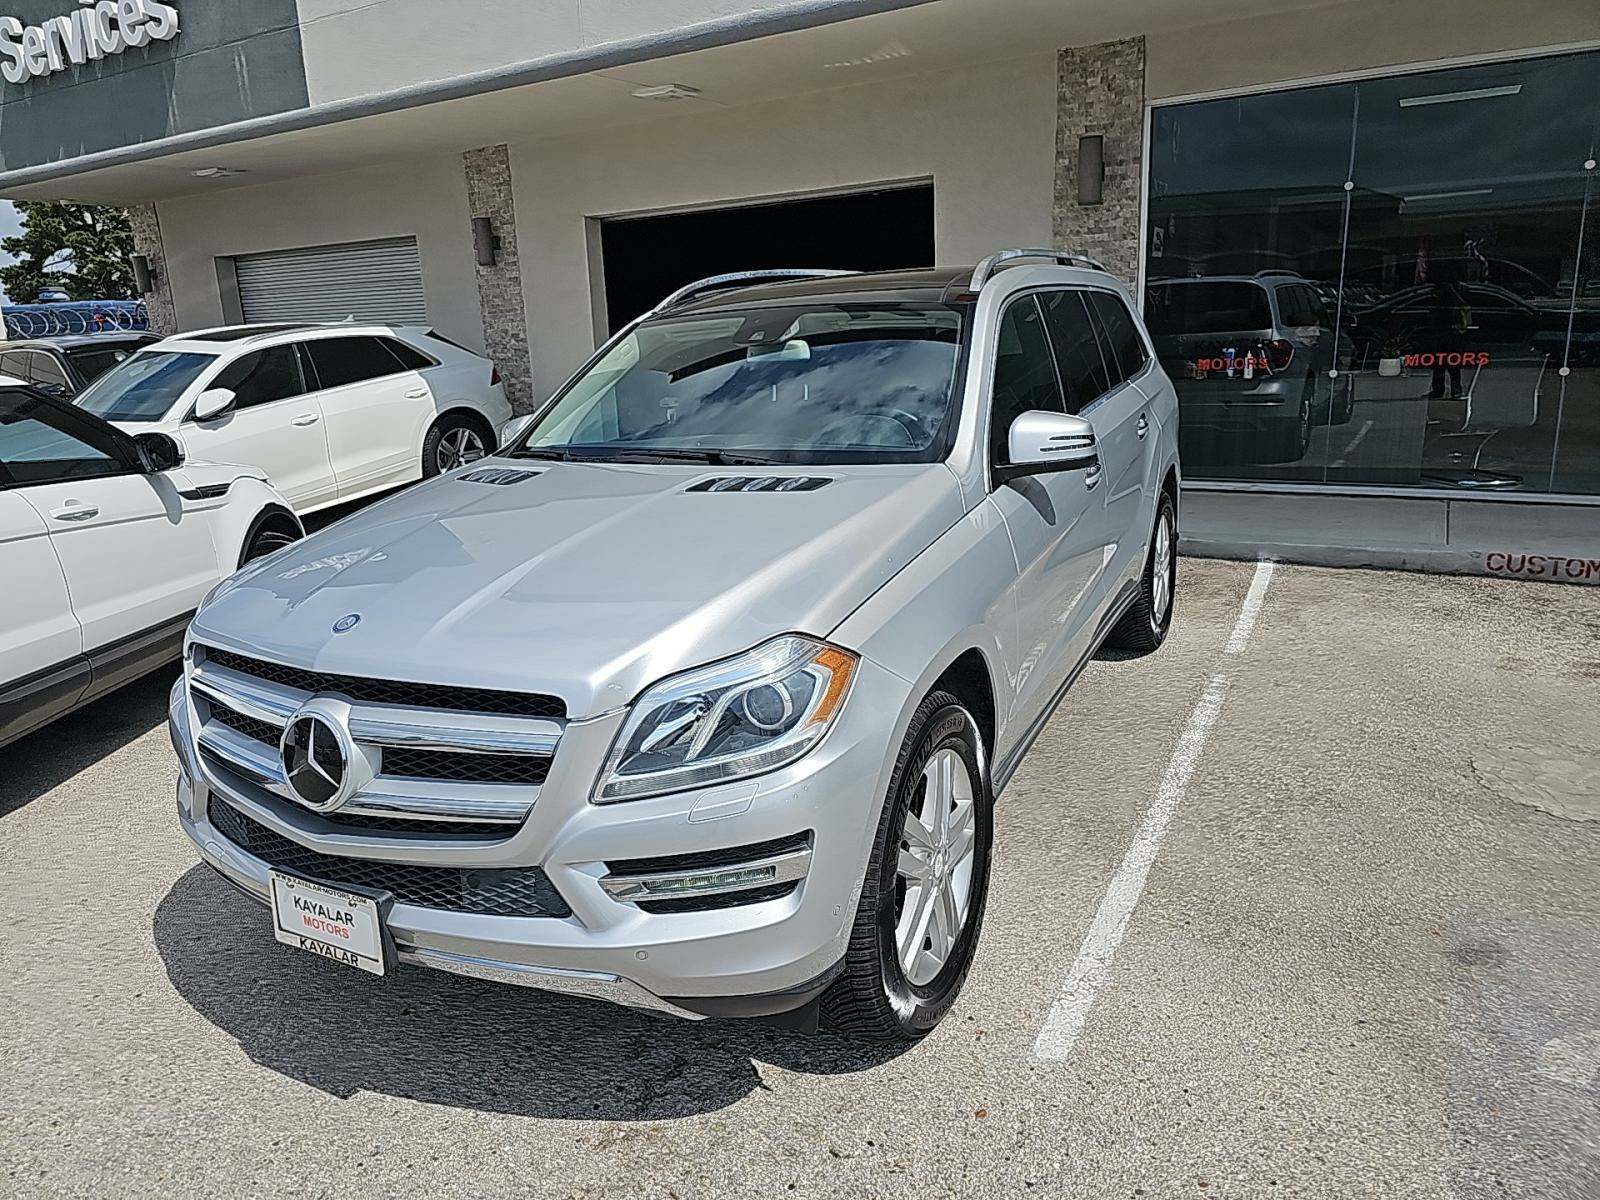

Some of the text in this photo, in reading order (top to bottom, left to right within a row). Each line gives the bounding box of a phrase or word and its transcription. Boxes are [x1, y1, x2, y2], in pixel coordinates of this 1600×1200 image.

[0, 0, 178, 83] Services
[1197, 358, 1268, 370] MOTORS
[1403, 352, 1490, 367] MOTORS
[293, 895, 355, 928] KAYALAR
[303, 915, 350, 939] MOTORS
[299, 938, 359, 966] KAYALAR
